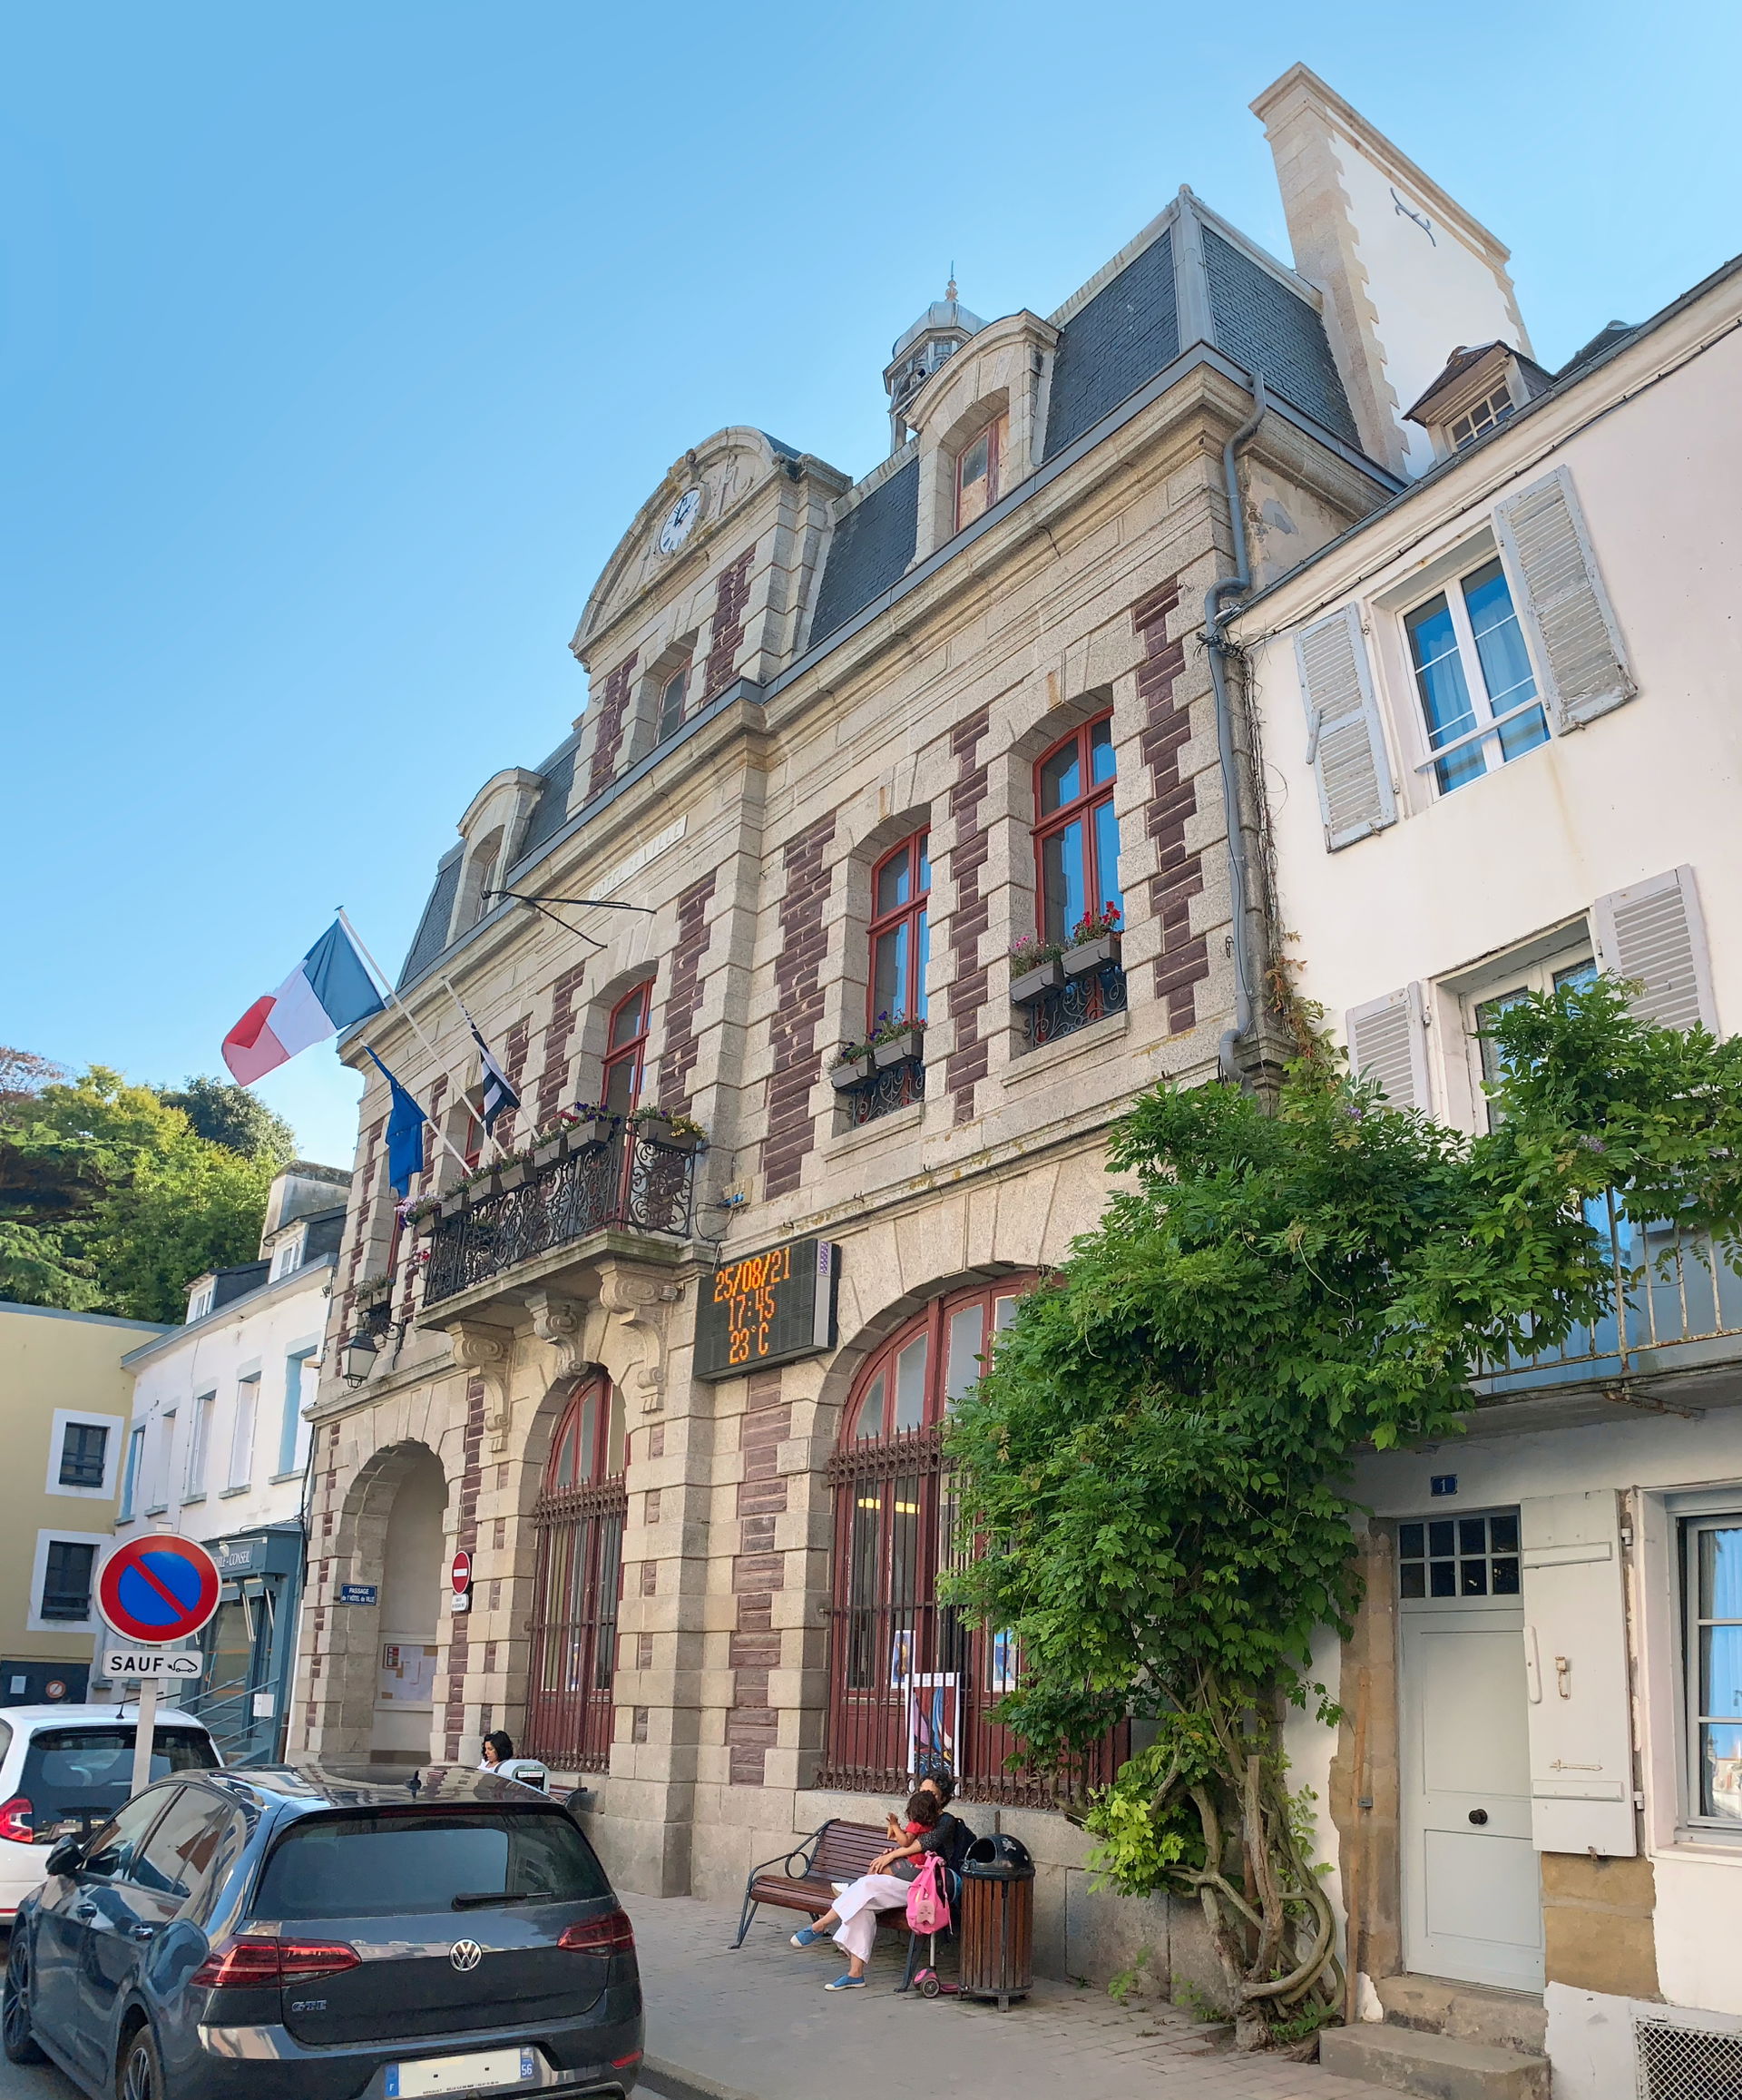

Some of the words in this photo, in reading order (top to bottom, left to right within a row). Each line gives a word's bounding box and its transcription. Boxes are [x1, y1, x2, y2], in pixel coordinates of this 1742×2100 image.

[714, 1247, 790, 1302] 25/08/21
[728, 1286, 776, 1331] 17:45
[1440, 1478, 1446, 1493] 1
[348, 1587, 369, 1595] PASSAGE
[111, 1656, 164, 1672] SAUF
[291, 1999, 328, 2012] GTE
[522, 2063, 533, 2076] 56
[389, 2083, 394, 2092] F
